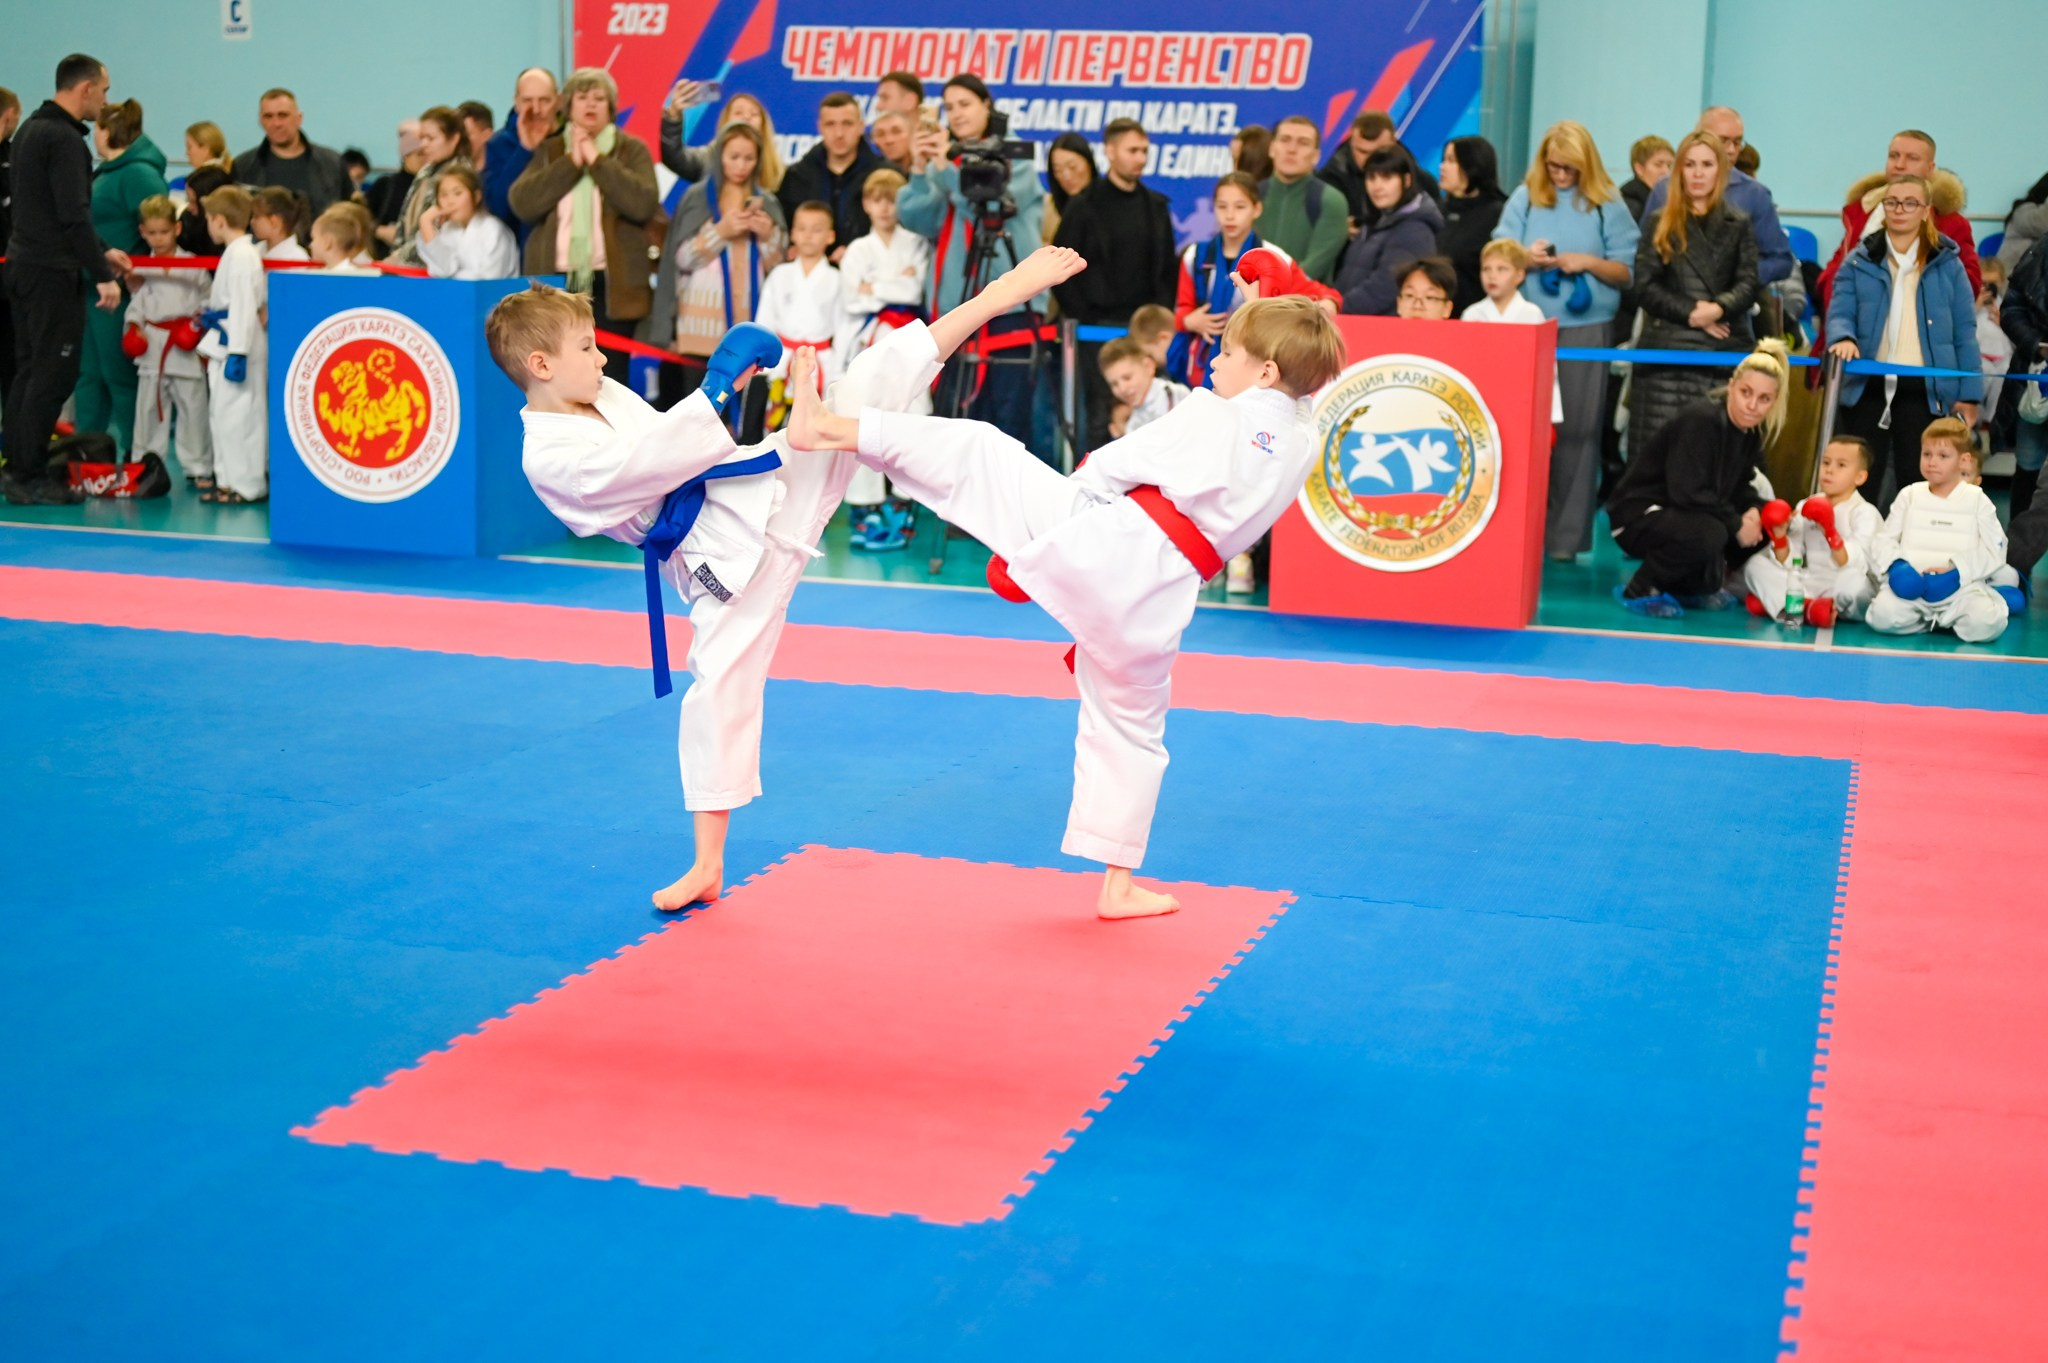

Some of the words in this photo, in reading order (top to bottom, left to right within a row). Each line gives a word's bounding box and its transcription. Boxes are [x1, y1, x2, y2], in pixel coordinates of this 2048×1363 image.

[608, 3, 668, 35] 2023
[783, 26, 1017, 83] ЧЕМПИОНАТ
[1014, 30, 1052, 85] И
[1048, 31, 1312, 89] ПЕРВЕНСТВО
[1159, 144, 1235, 178] ЕДИН
[301, 322, 357, 379] ФЕДЕРАЦИЯ
[359, 320, 406, 339] КАРАТЭ
[1318, 373, 1384, 435] ФЕДЕРАЦИЯ
[1392, 372, 1448, 395] КАРАТЭ
[1451, 393, 1487, 450] РОССИИ
[1310, 472, 1341, 527] KARATE
[1340, 524, 1426, 557] FEDERATION
[1429, 530, 1447, 548] OF
[1447, 494, 1484, 537] RUSSIA
